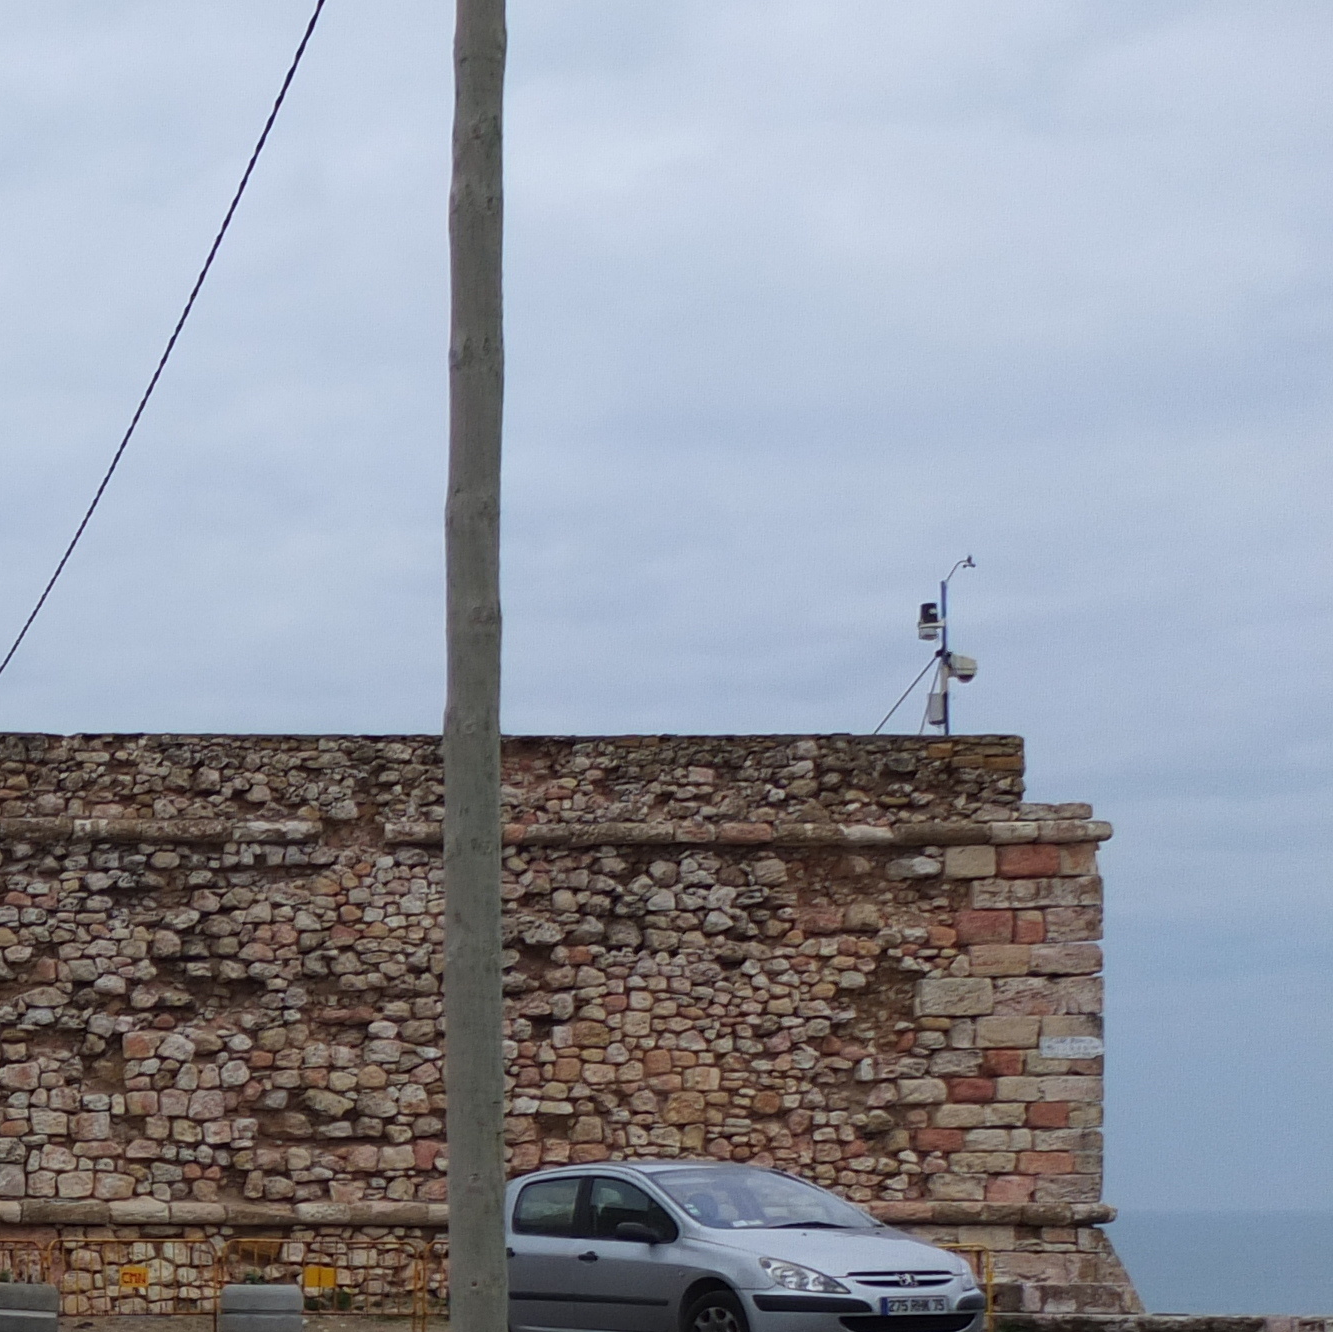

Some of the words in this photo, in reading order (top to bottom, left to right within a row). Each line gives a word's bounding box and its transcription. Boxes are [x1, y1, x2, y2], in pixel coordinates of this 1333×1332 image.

[122, 1272, 146, 1283] CMN
[888, 1299, 909, 1312] 275
[933, 1298, 945, 1311] 75
